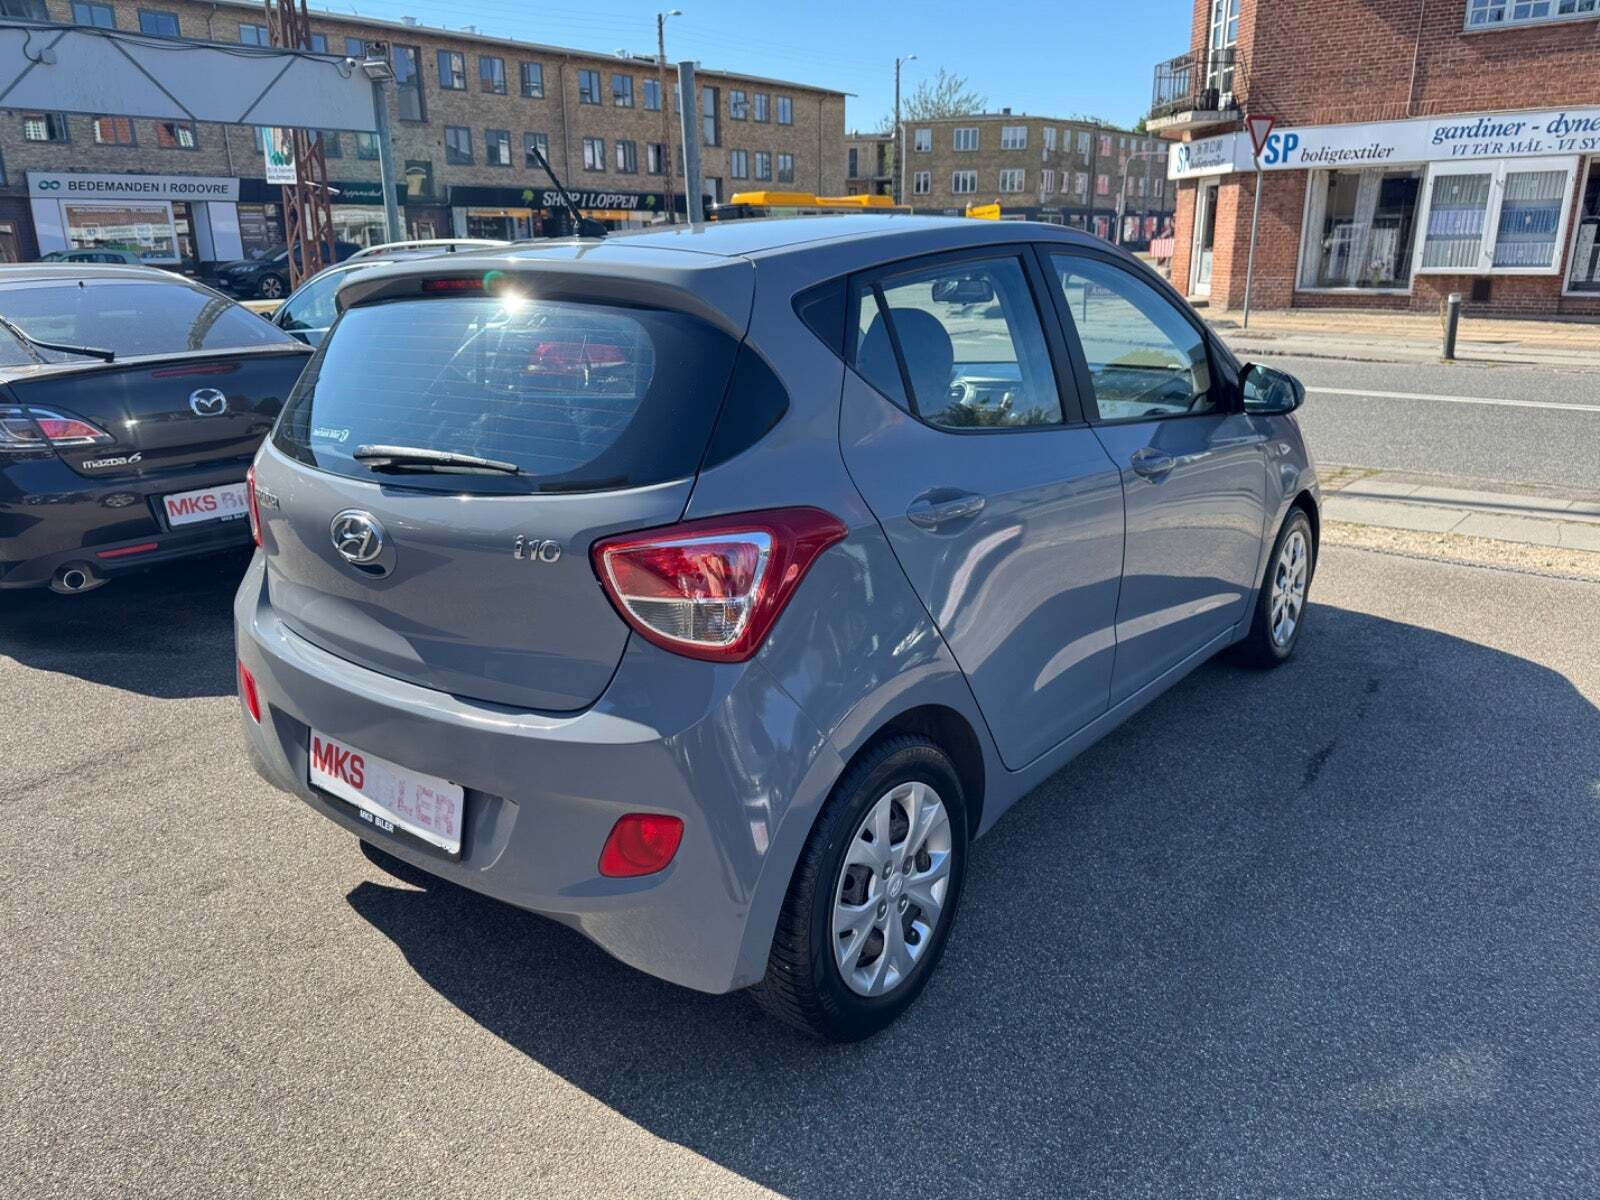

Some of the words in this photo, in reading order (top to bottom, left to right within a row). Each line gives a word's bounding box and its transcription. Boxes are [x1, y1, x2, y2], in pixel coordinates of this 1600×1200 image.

[1432, 117, 1526, 145] gardiner
[1264, 133, 1299, 165] SP
[1300, 143, 1394, 164] boligtextiler
[1451, 143, 1469, 156] VI
[1507, 138, 1544, 153] MÅL
[1557, 138, 1575, 151] VI
[68, 181, 159, 192] BEDEMANDEN
[170, 183, 229, 194] RØDOVRE
[581, 194, 587, 208] I
[588, 194, 639, 208] LOPPEN
[167, 494, 217, 516] MKS
[513, 534, 561, 563] i10
[314, 737, 366, 790] MKS
